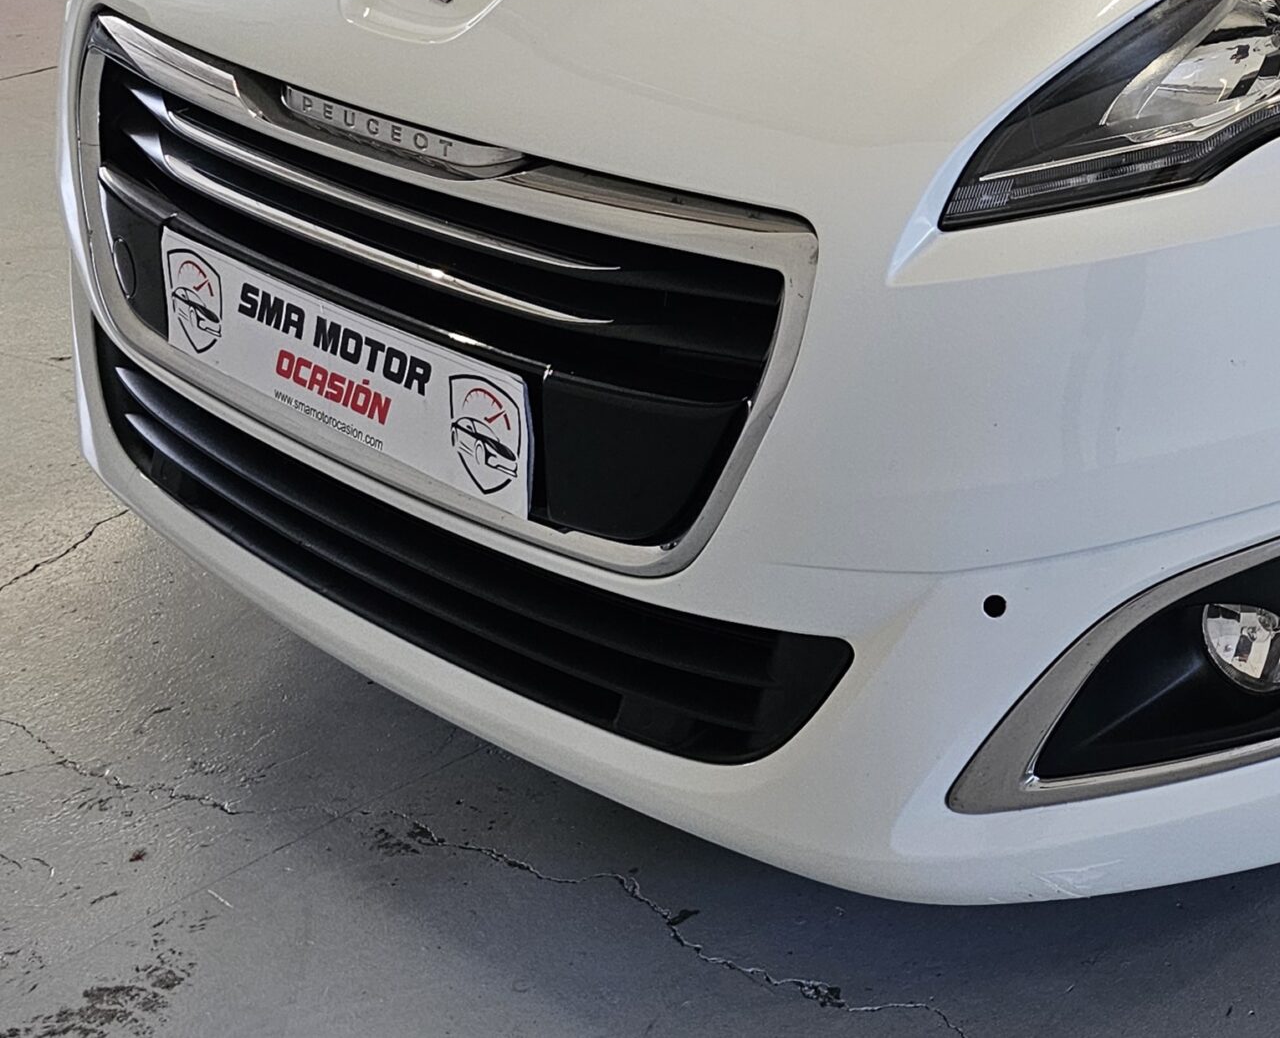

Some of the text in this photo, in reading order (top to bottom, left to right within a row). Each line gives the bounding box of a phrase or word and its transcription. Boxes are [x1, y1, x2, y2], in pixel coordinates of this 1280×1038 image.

[301, 96, 453, 157] PEUGEOT
[237, 282, 432, 396] SMA MOTOR
[273, 388, 384, 451] www.smamotorocasion.com
[275, 349, 392, 425] OCASIÓN
